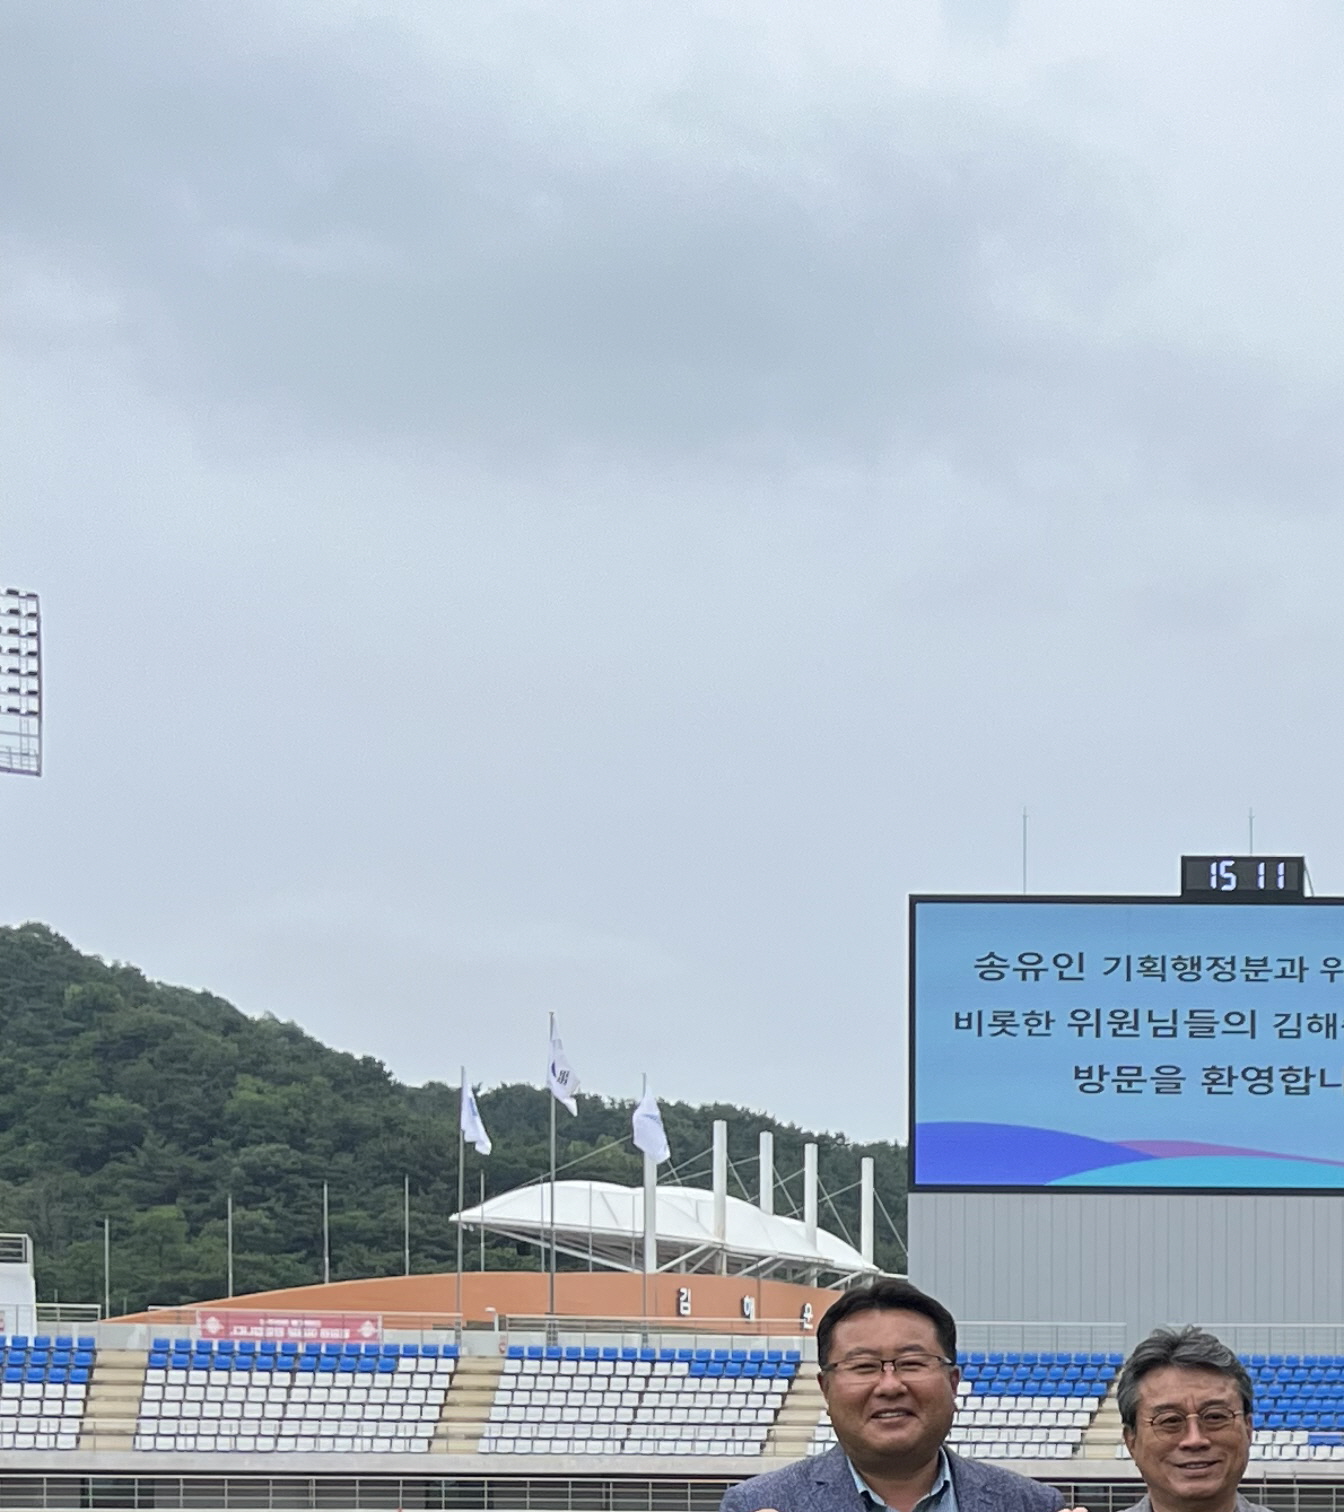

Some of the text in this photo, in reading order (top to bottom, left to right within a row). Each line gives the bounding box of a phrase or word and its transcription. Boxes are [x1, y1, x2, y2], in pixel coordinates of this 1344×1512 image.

[1210, 860, 1285, 891] 15 11
[973, 950, 1086, 983] 송유인
[1102, 954, 1310, 984] 기획행정분과
[954, 1009, 1057, 1038] 비롯한
[1066, 1007, 1257, 1040] 위원님들의
[1073, 1063, 1187, 1095] 방문을
